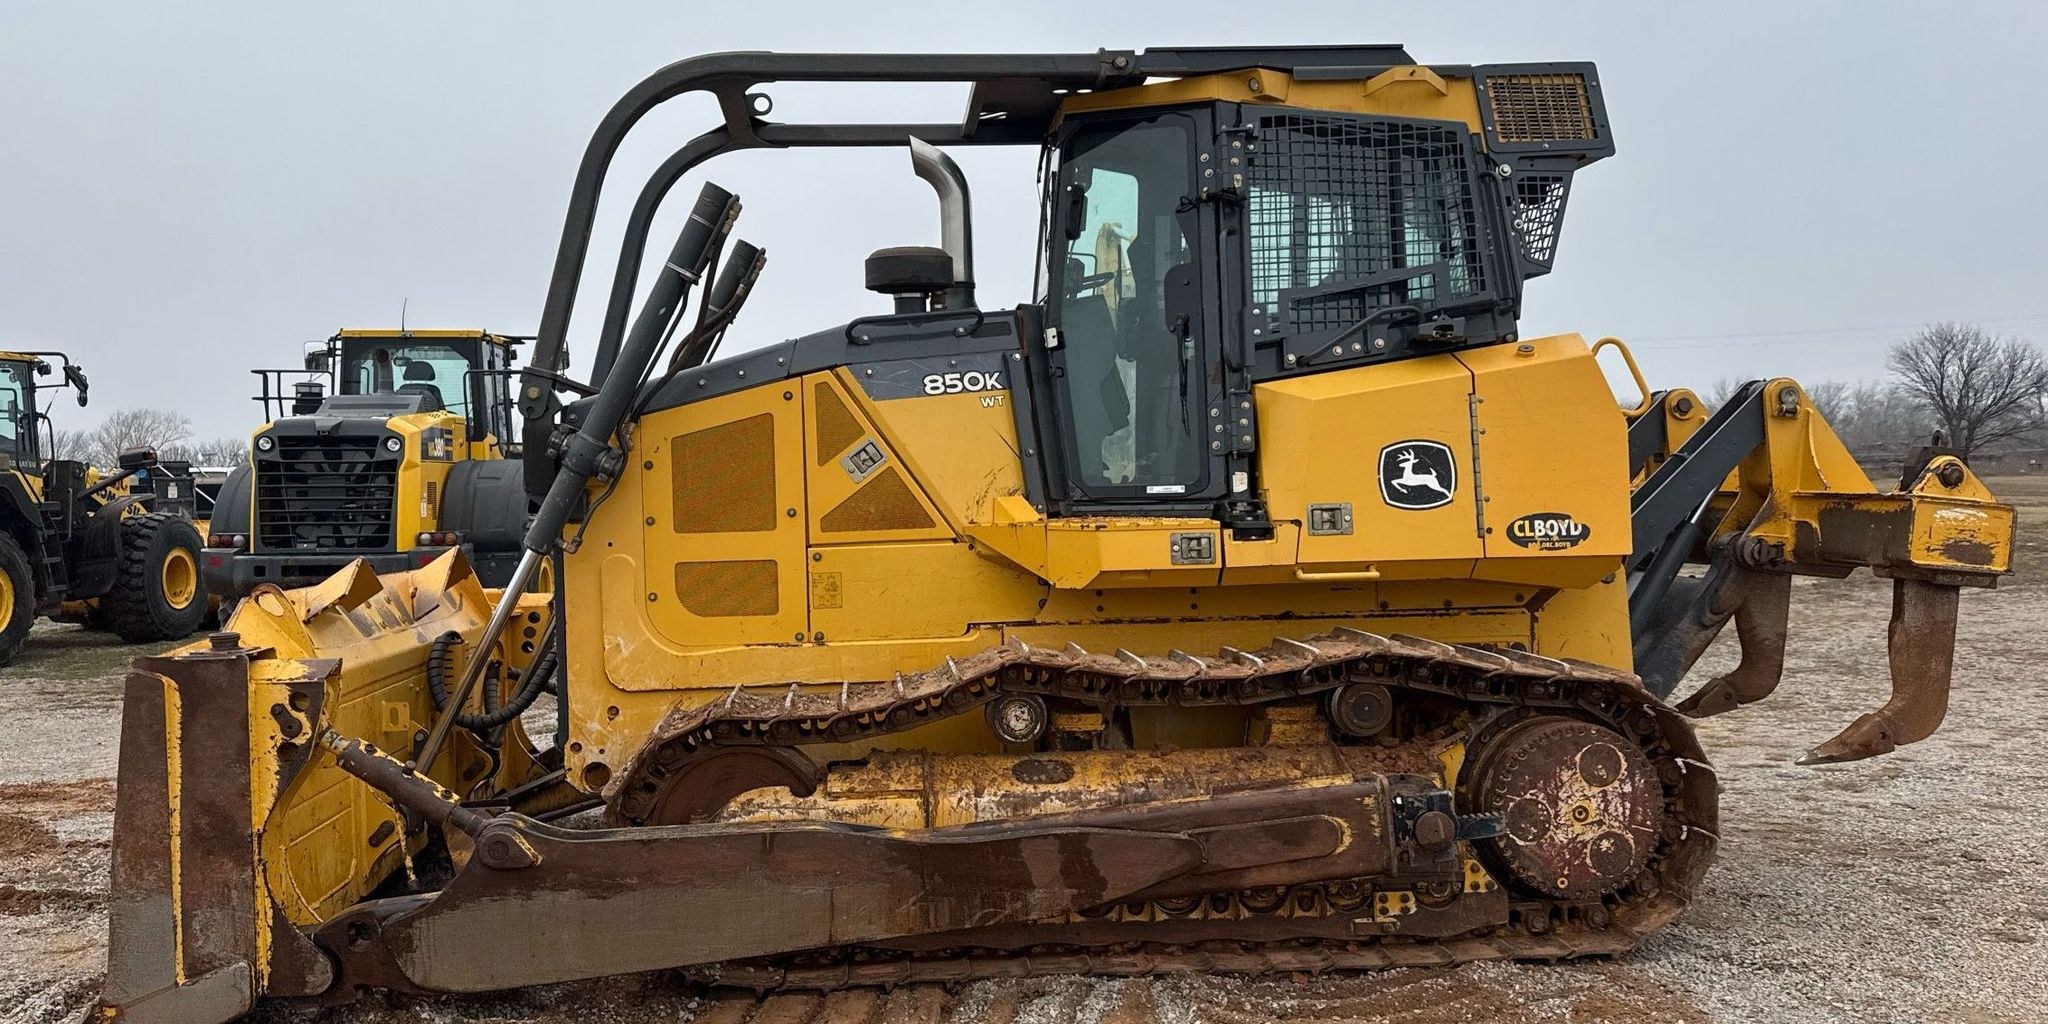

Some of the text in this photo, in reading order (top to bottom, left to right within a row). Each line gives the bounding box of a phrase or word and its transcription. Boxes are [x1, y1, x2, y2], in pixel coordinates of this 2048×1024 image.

[924, 371, 1003, 395] 850K
[980, 396, 1005, 408] WT
[1513, 519, 1582, 537] CLBOYD
